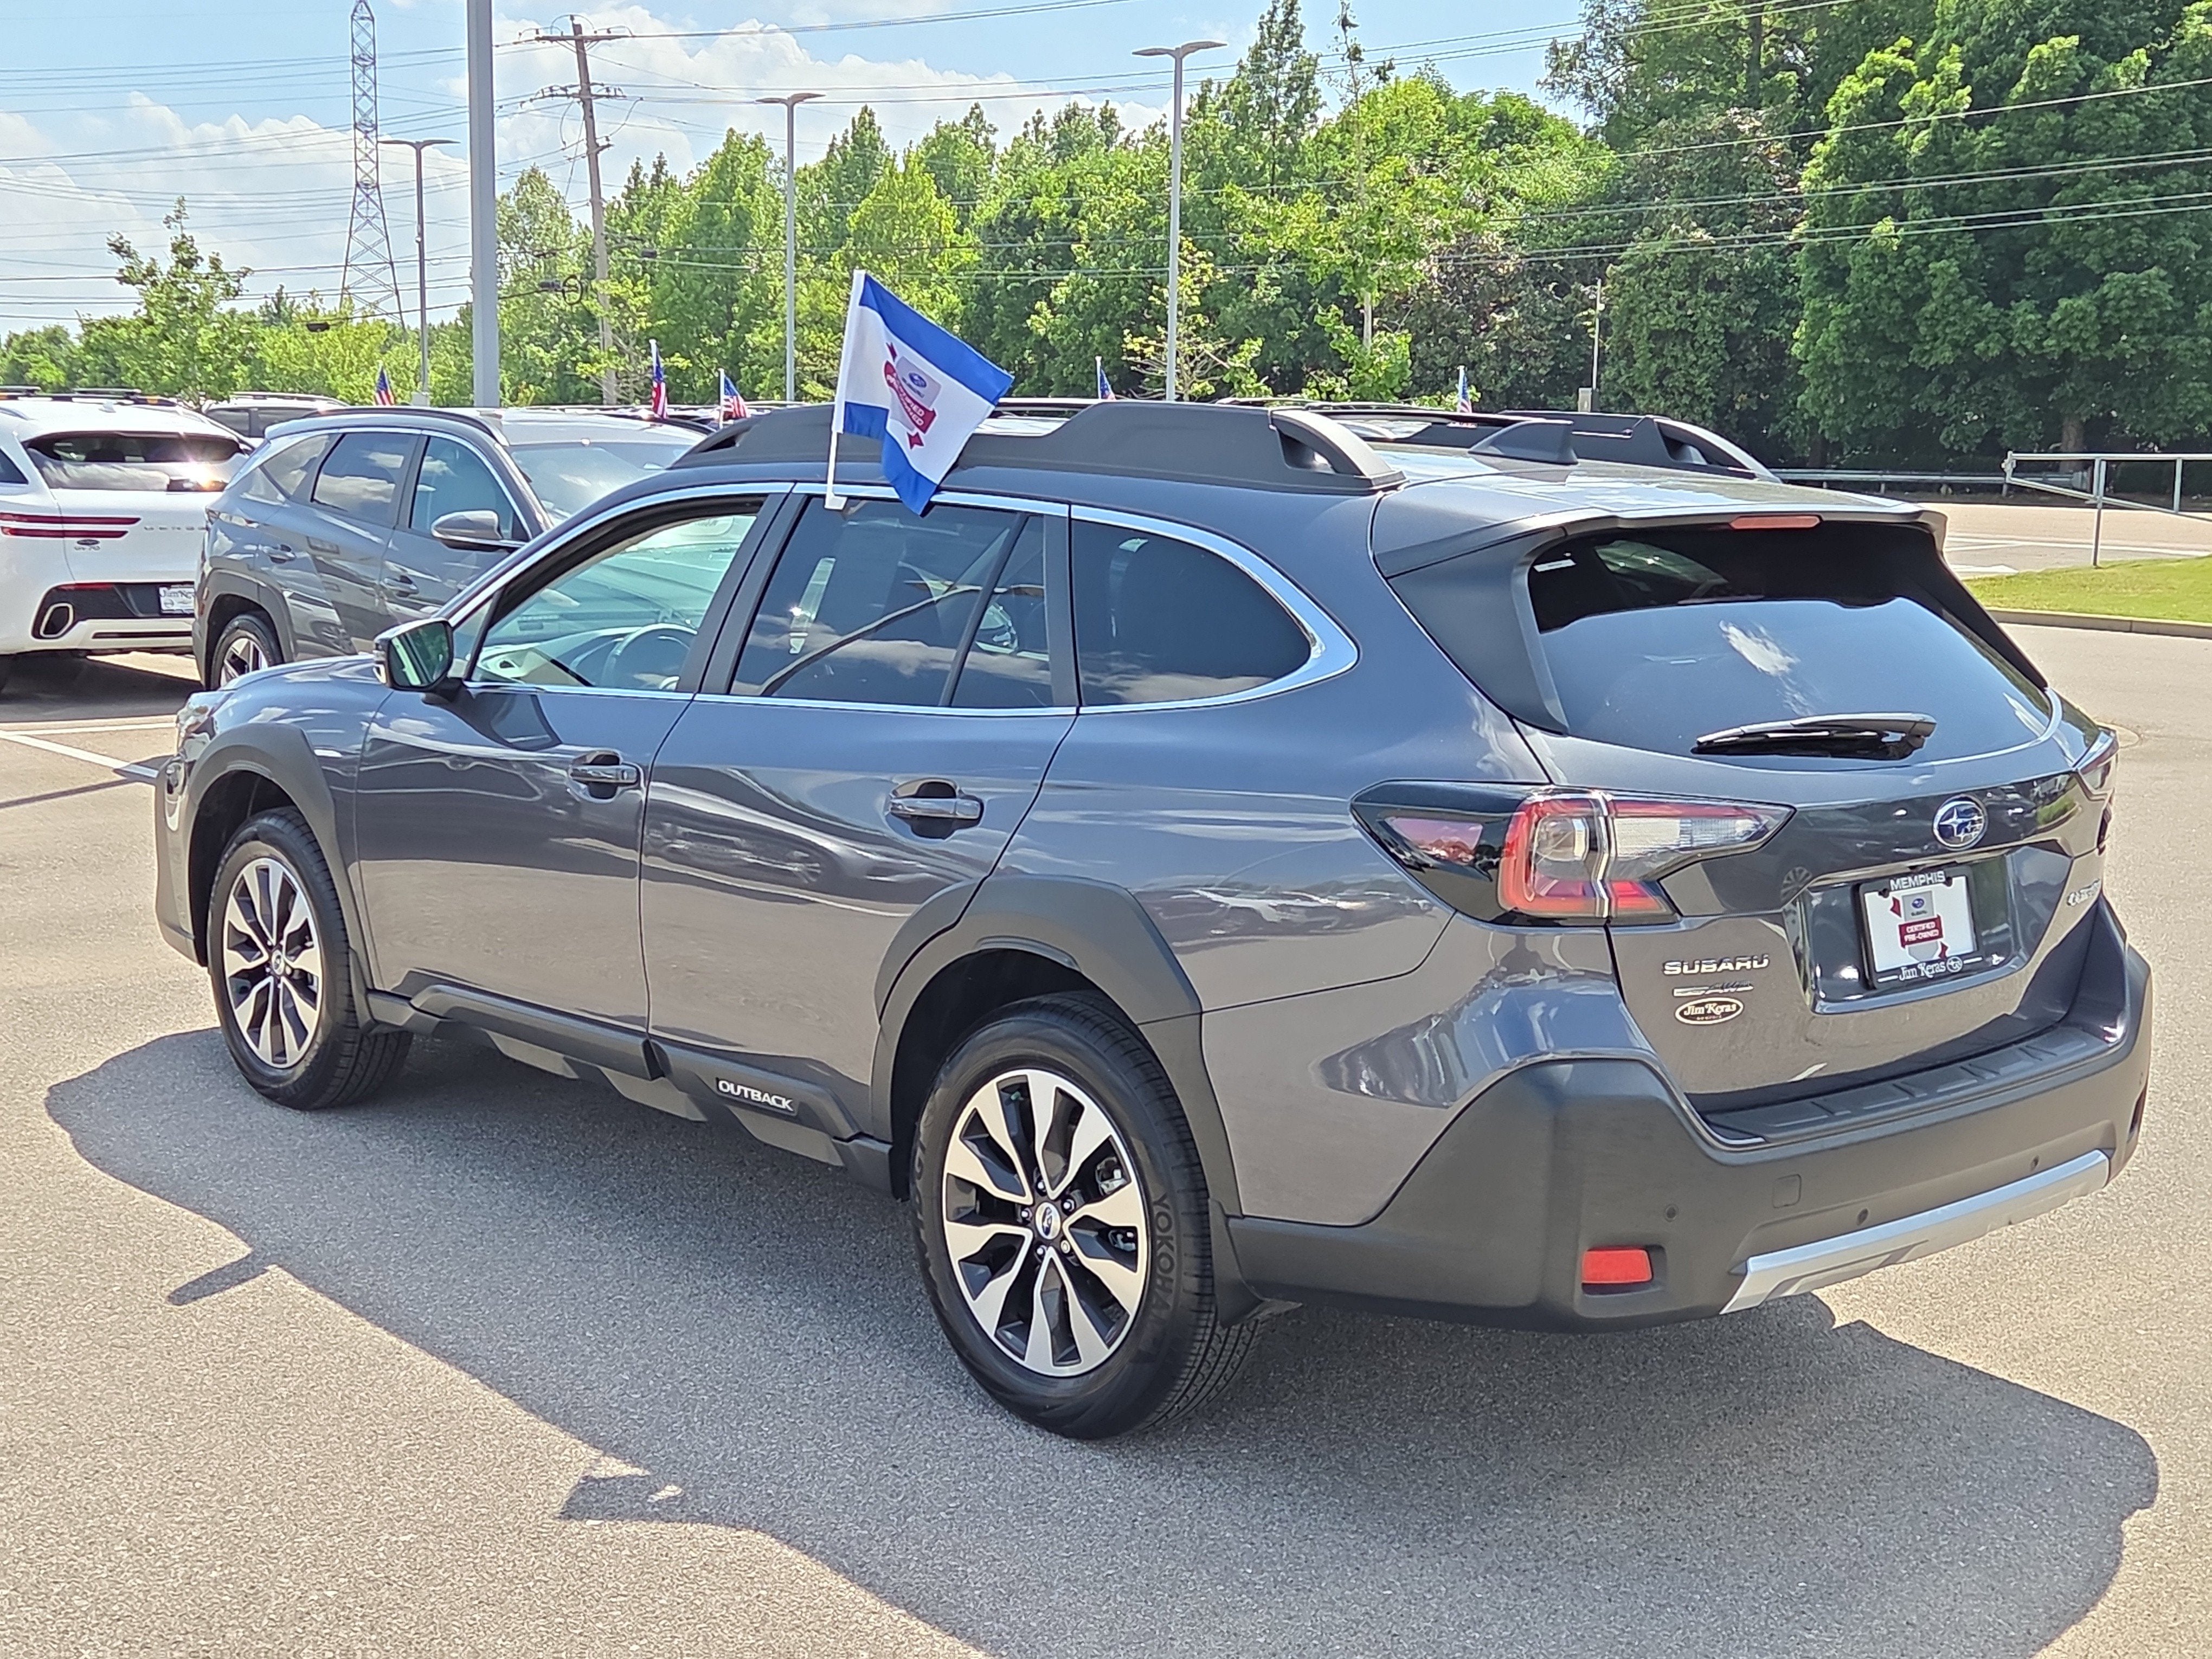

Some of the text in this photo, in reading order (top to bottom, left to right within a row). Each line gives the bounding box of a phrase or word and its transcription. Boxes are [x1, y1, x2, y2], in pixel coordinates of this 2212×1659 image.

[1890, 871, 1946, 891] MEMPHIS
[1664, 954, 1769, 974] SUBARU
[1899, 962, 1946, 981] Jim Keras
[1683, 1003, 1737, 1015] Jim Keras
[718, 1080, 794, 1111] OUTBACK
[1150, 1193, 1175, 1321] YOKOHA
